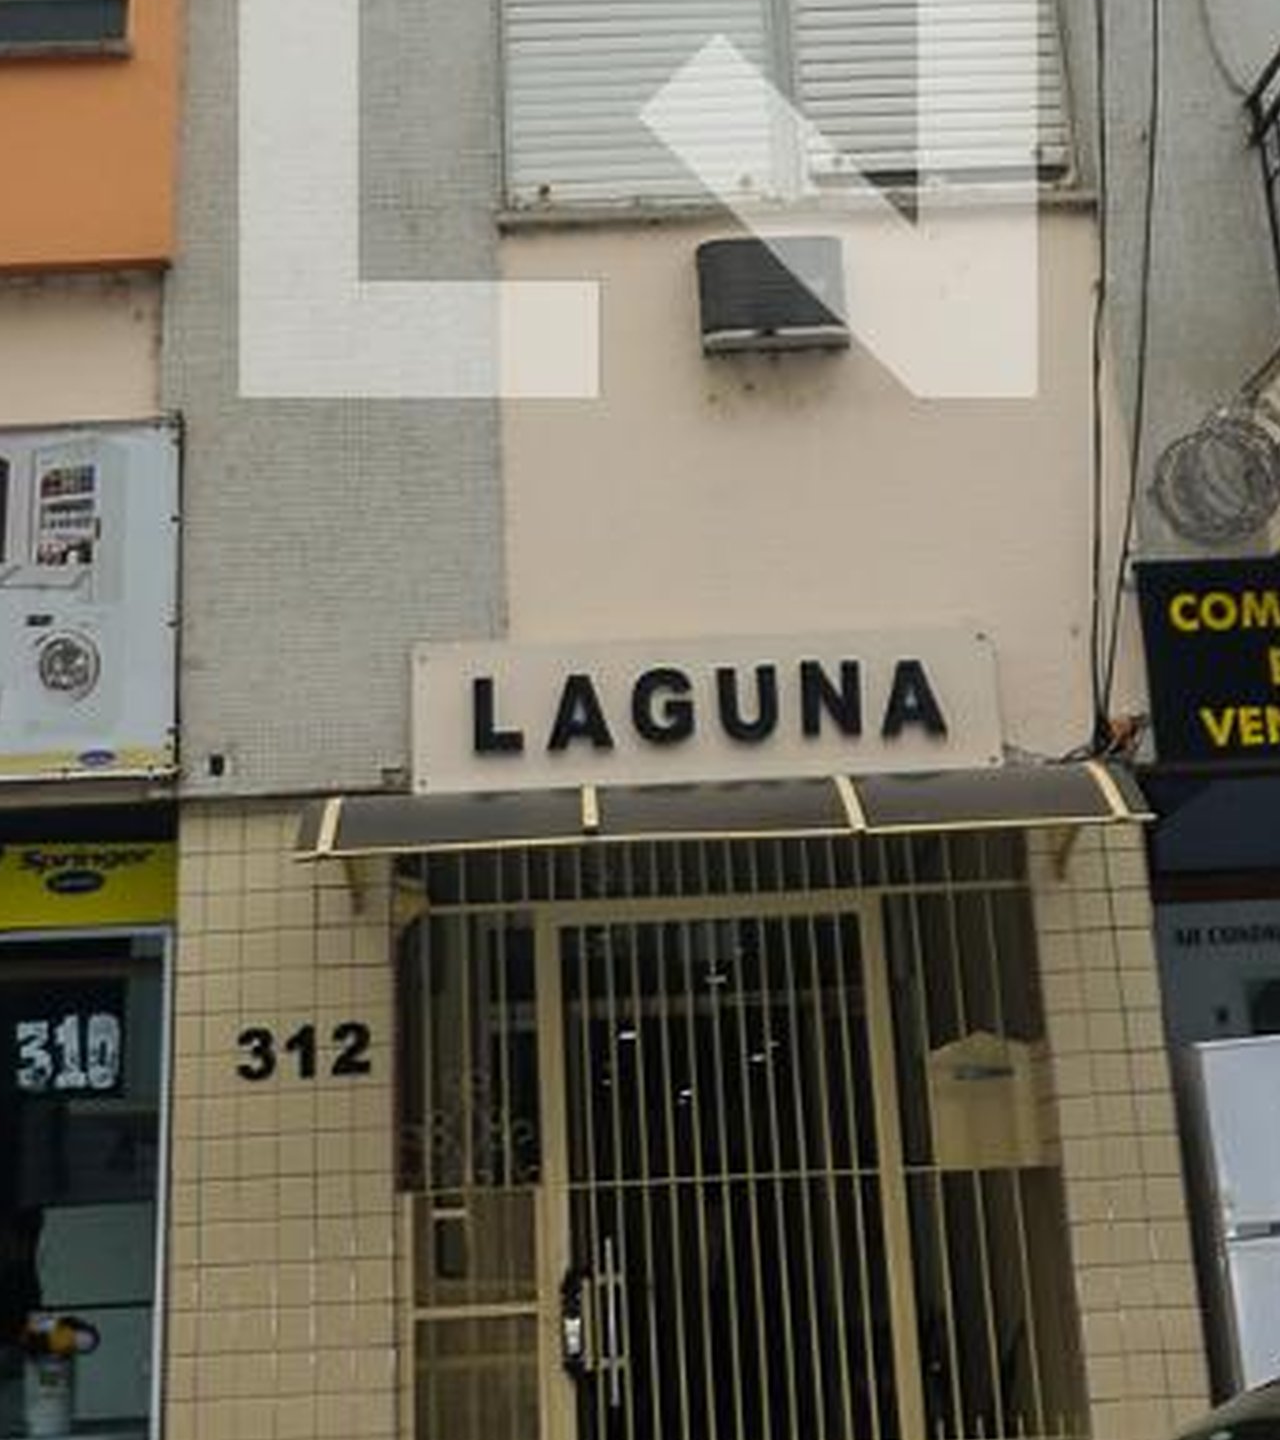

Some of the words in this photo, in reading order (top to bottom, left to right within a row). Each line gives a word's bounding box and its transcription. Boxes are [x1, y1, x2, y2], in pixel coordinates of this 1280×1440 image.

[472, 660, 949, 754] LAGUNA
[16, 1013, 120, 1090] 310
[236, 1022, 372, 1080] 312
